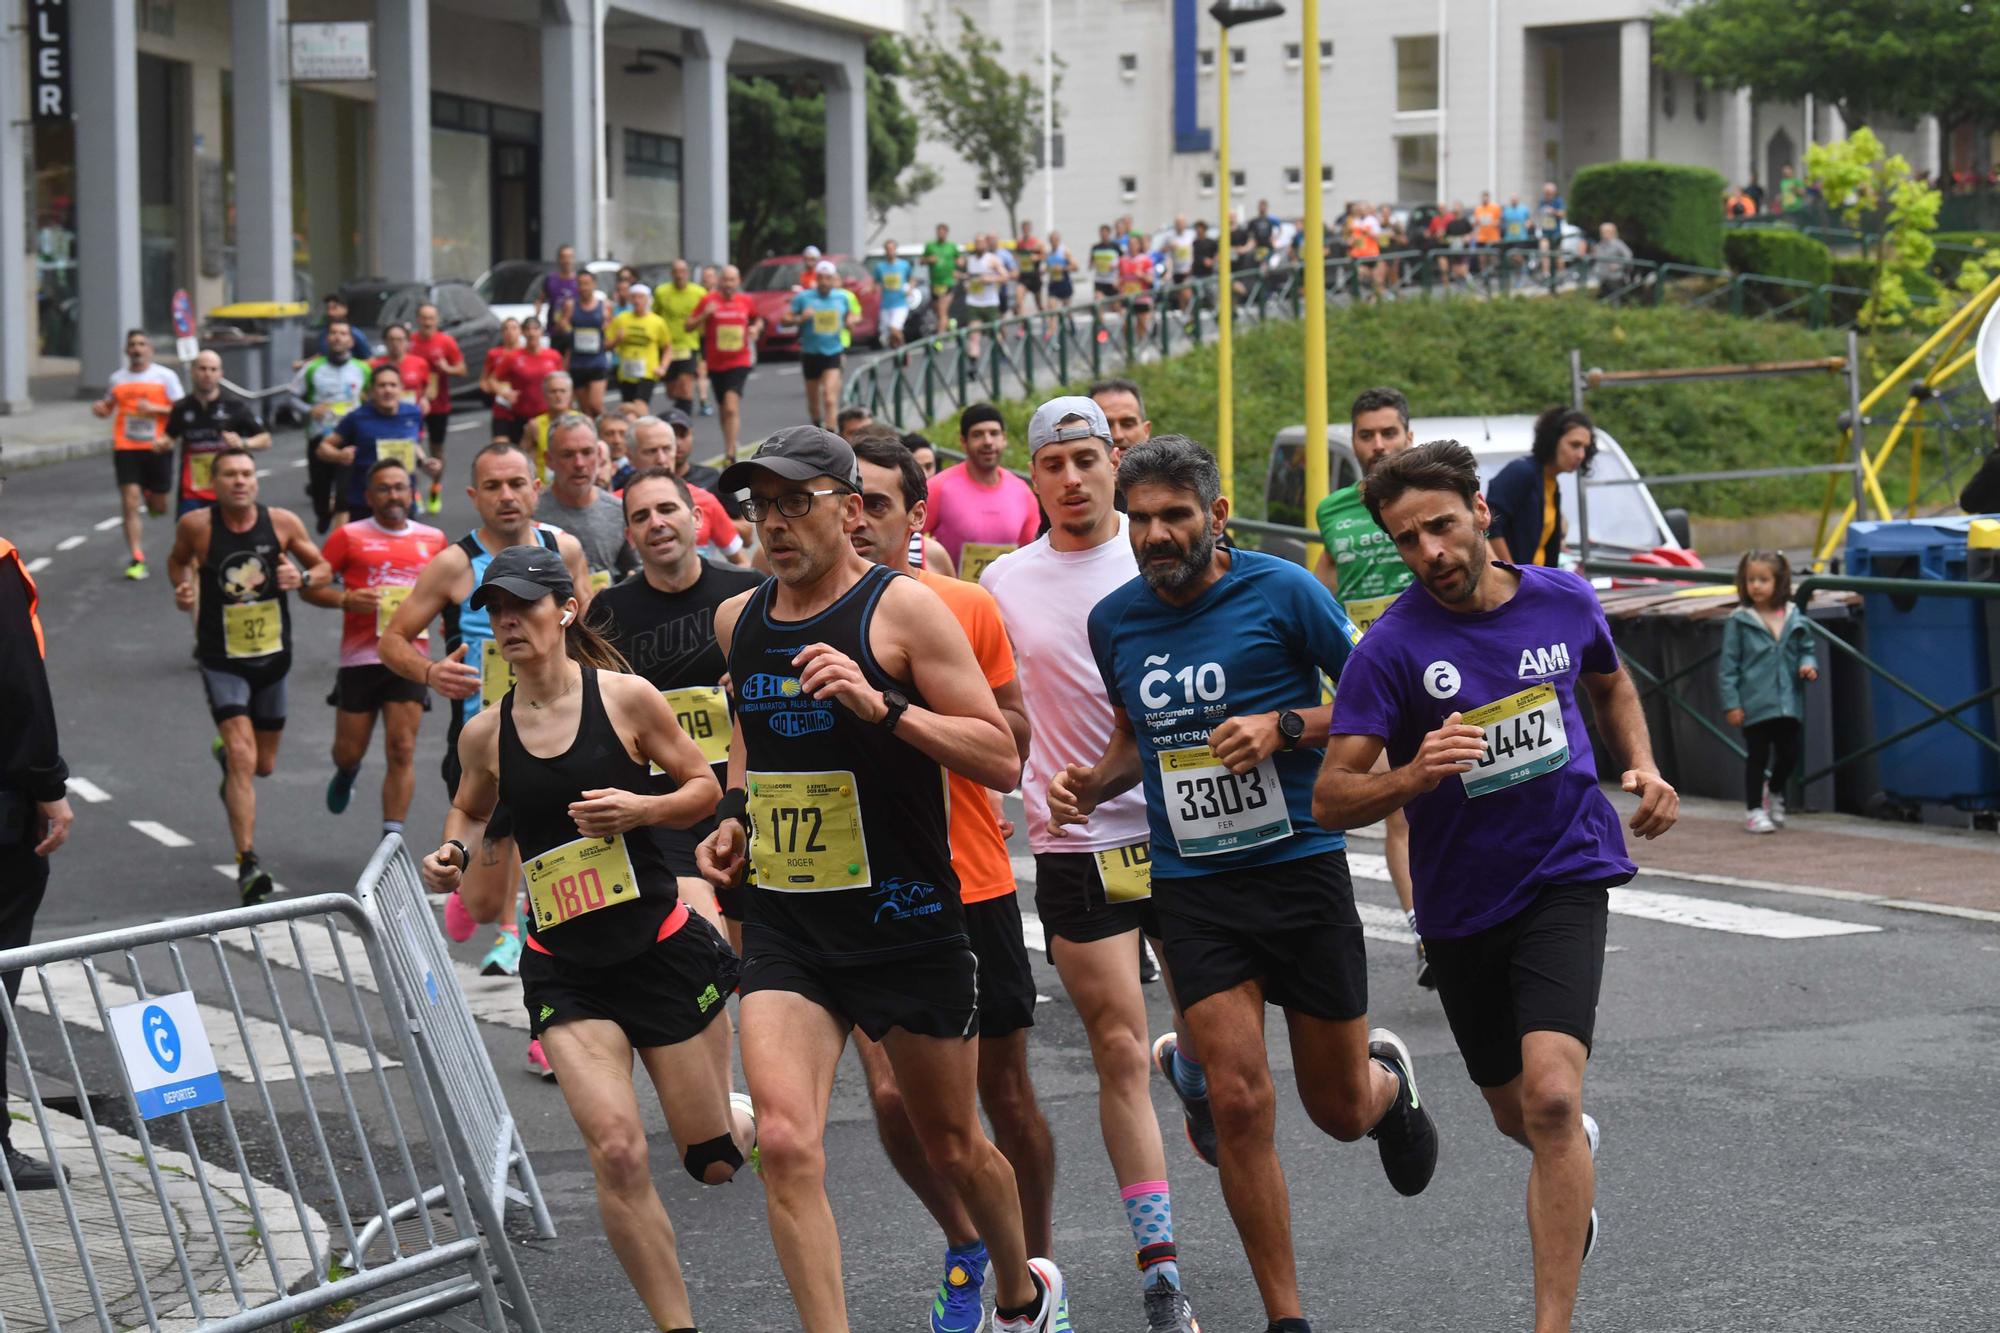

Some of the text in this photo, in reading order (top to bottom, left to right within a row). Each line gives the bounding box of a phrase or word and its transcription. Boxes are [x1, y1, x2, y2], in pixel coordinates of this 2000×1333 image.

[38, 0, 62, 115] LER
[244, 618, 266, 640] 32
[1145, 703, 1227, 721] XVI Carreira 24.04
[1147, 718, 1177, 729] Popular
[1510, 768, 1531, 781] 22.05
[1176, 766, 1268, 821] 3303
[771, 807, 827, 853] 172
[1217, 821, 1234, 829] FER
[1218, 837, 1238, 846] 22.05
[787, 858, 815, 867] ROGER
[551, 867, 607, 921] 180
[163, 1086, 198, 1105] DEPORTES
